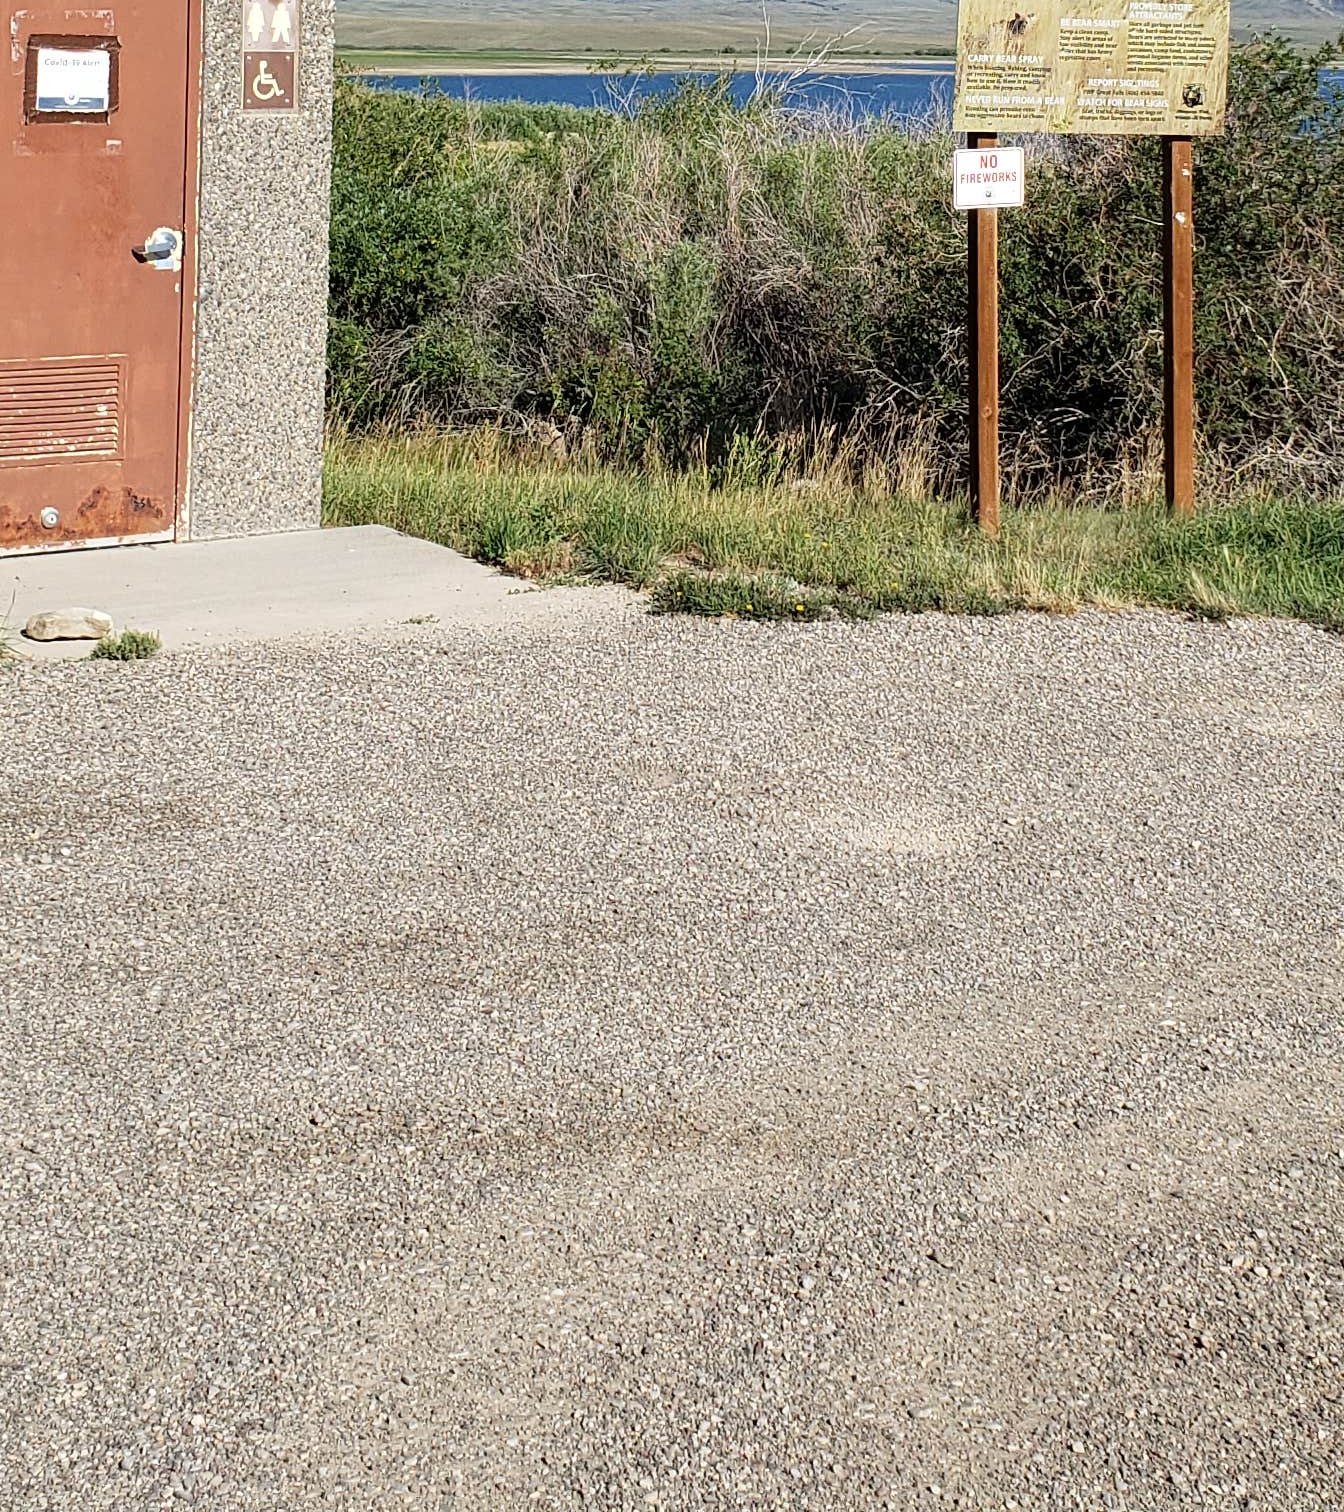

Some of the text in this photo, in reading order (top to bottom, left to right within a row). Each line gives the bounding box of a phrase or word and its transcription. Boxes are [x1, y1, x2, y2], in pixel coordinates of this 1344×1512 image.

[968, 54, 1043, 63] CARRY BEAR SPRAY
[1088, 78, 1117, 87] REPORT
[965, 95, 990, 103] NEVER
[992, 95, 1010, 104] RUN
[1011, 95, 1035, 104] FROM
[1044, 96, 1065, 105] BEAR
[1077, 98, 1106, 107] WATCH
[1107, 98, 1123, 107] FOR
[1124, 99, 1145, 107] BEAR
[980, 155, 998, 169] NO
[960, 171, 1017, 185] FIREWORKS
